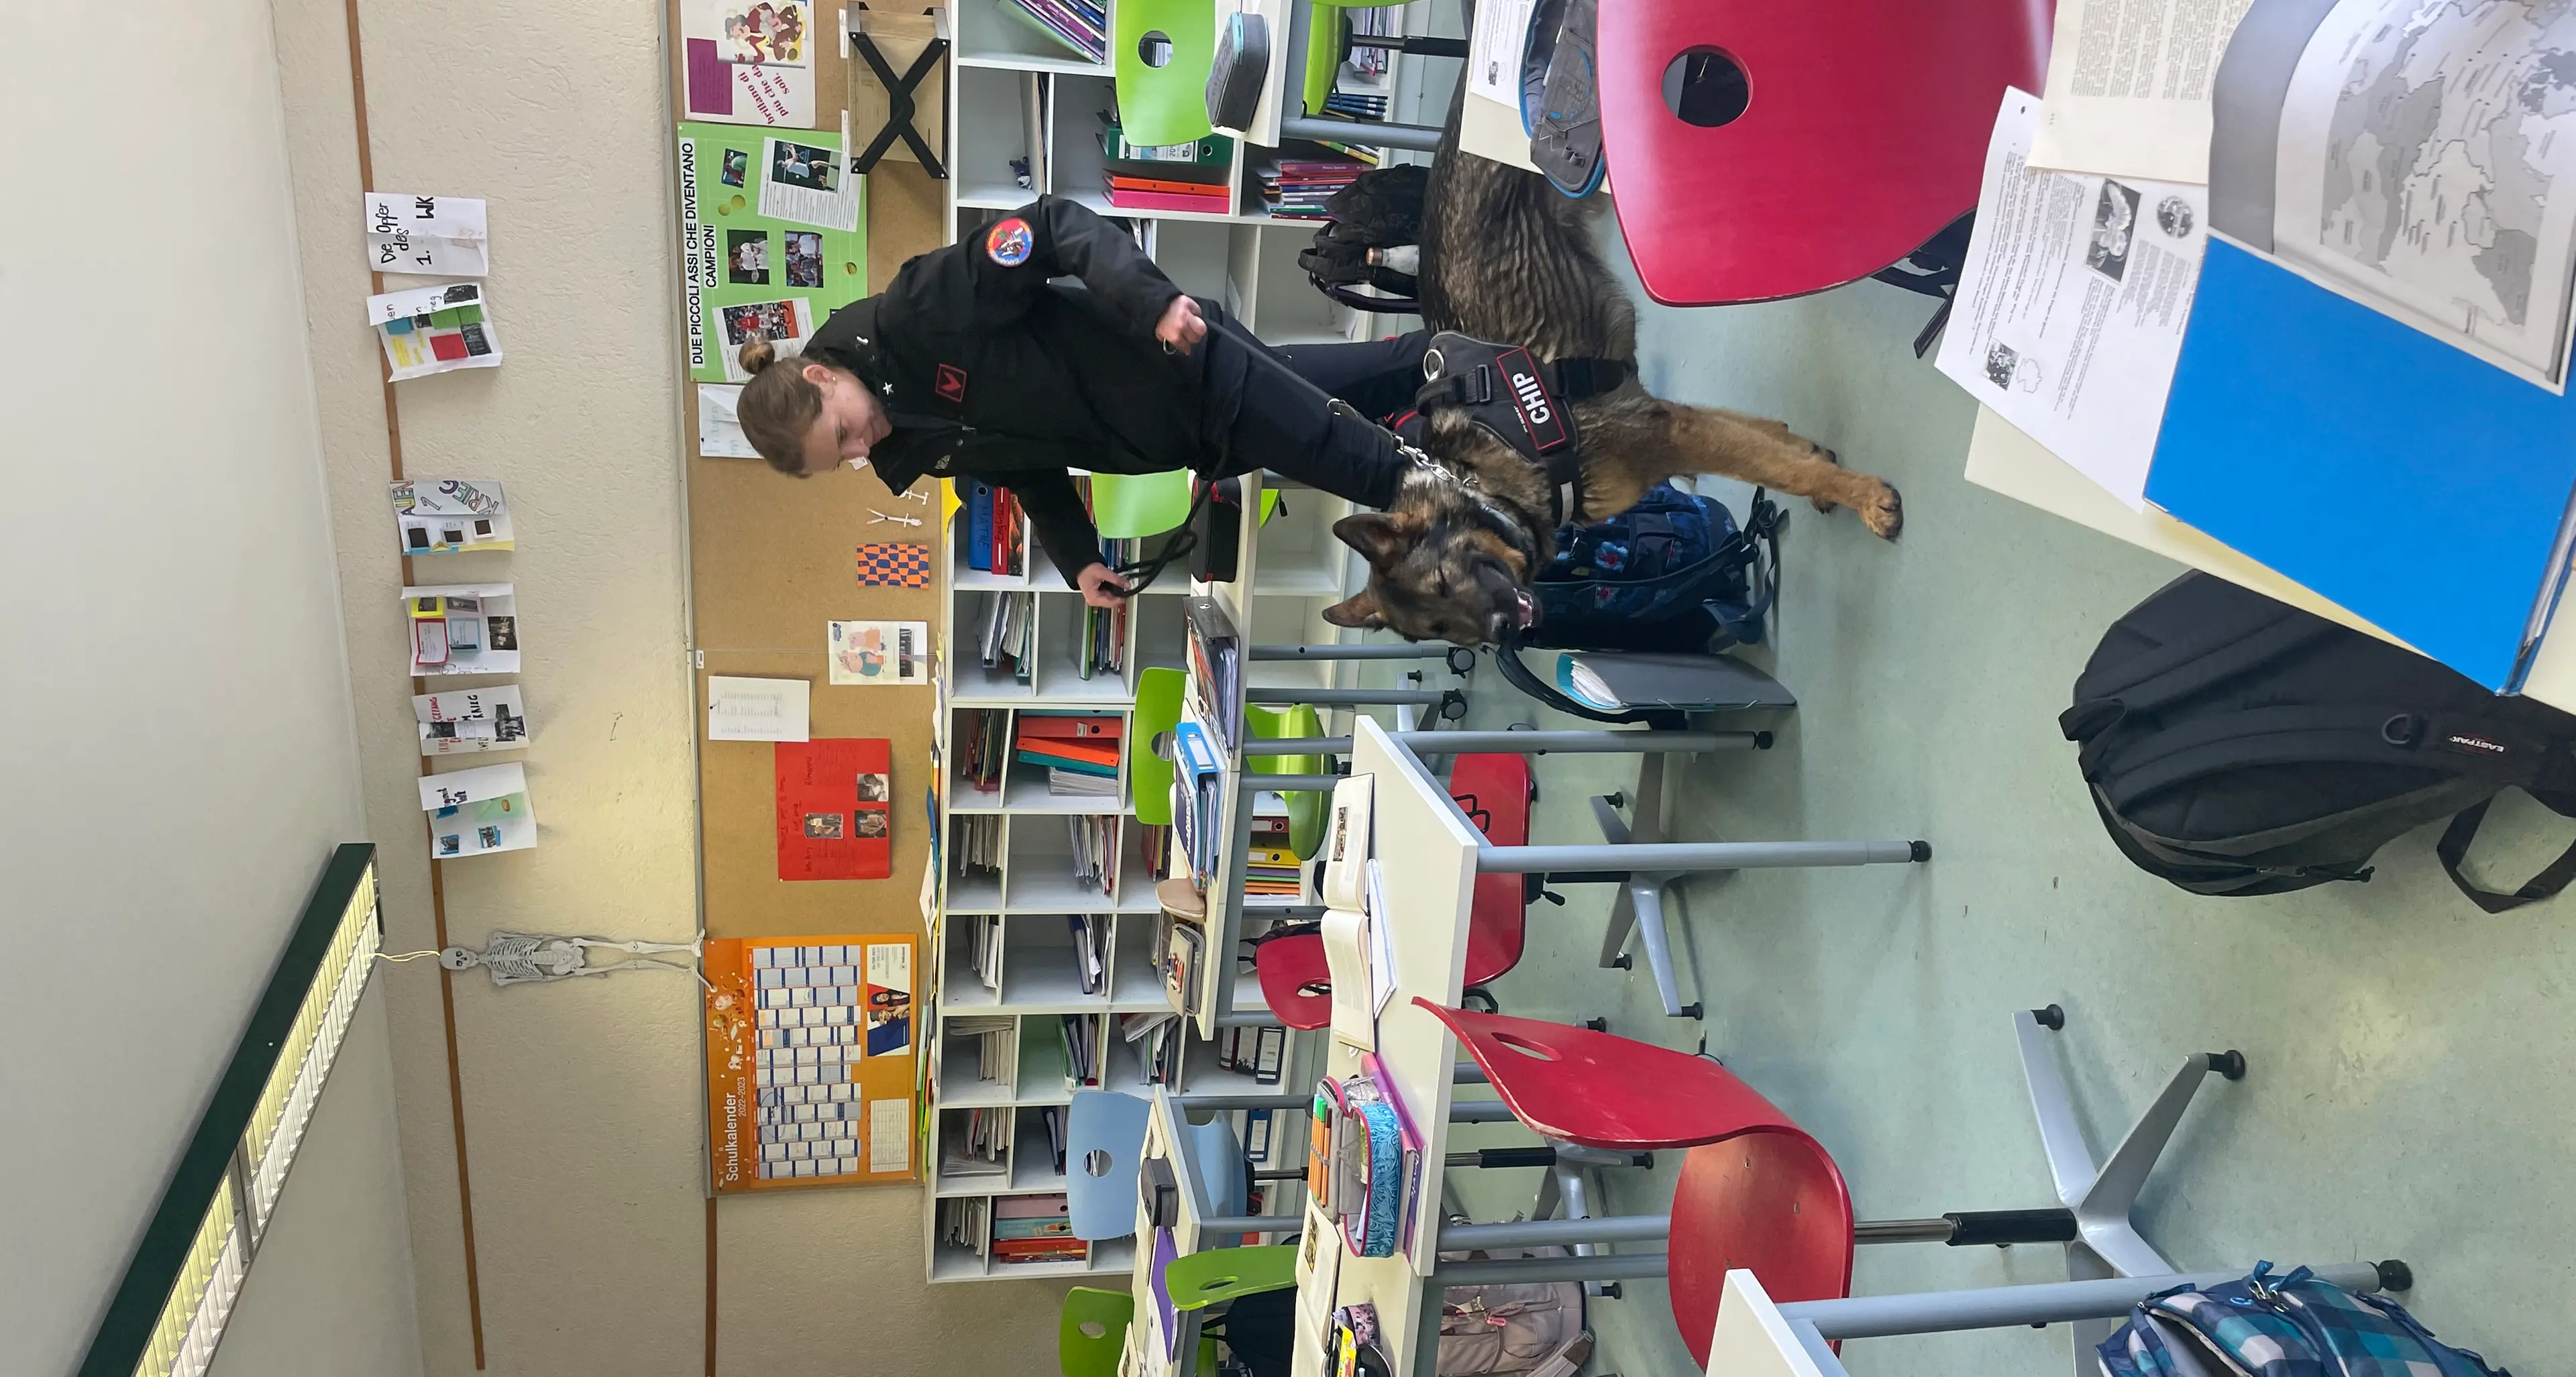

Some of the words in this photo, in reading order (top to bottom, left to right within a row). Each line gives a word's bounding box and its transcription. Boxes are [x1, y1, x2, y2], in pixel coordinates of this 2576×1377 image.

[737, 72, 751, 82] di
[749, 64, 765, 78] da
[775, 72, 791, 95] soli.
[761, 78, 777, 98] che
[745, 84, 775, 125] brillano
[771, 99, 789, 118] più
[682, 142, 696, 219] DIVENTANO
[375, 203, 398, 233] Opfer
[415, 197, 434, 219] WK
[392, 228, 409, 251] des
[685, 222, 698, 250] CHE
[380, 243, 396, 264] Die
[416, 250, 431, 266] 1.
[703, 225, 716, 288] CAMPIONI
[686, 253, 700, 283] ASSI
[688, 285, 702, 335] PICCOLI
[691, 337, 704, 364] DUE
[1512, 372, 1551, 425] CHIP
[438, 480, 499, 514] KRIEG
[2449, 736, 2505, 753] EASTPAK
[724, 1092, 739, 1181] Schulkalender
